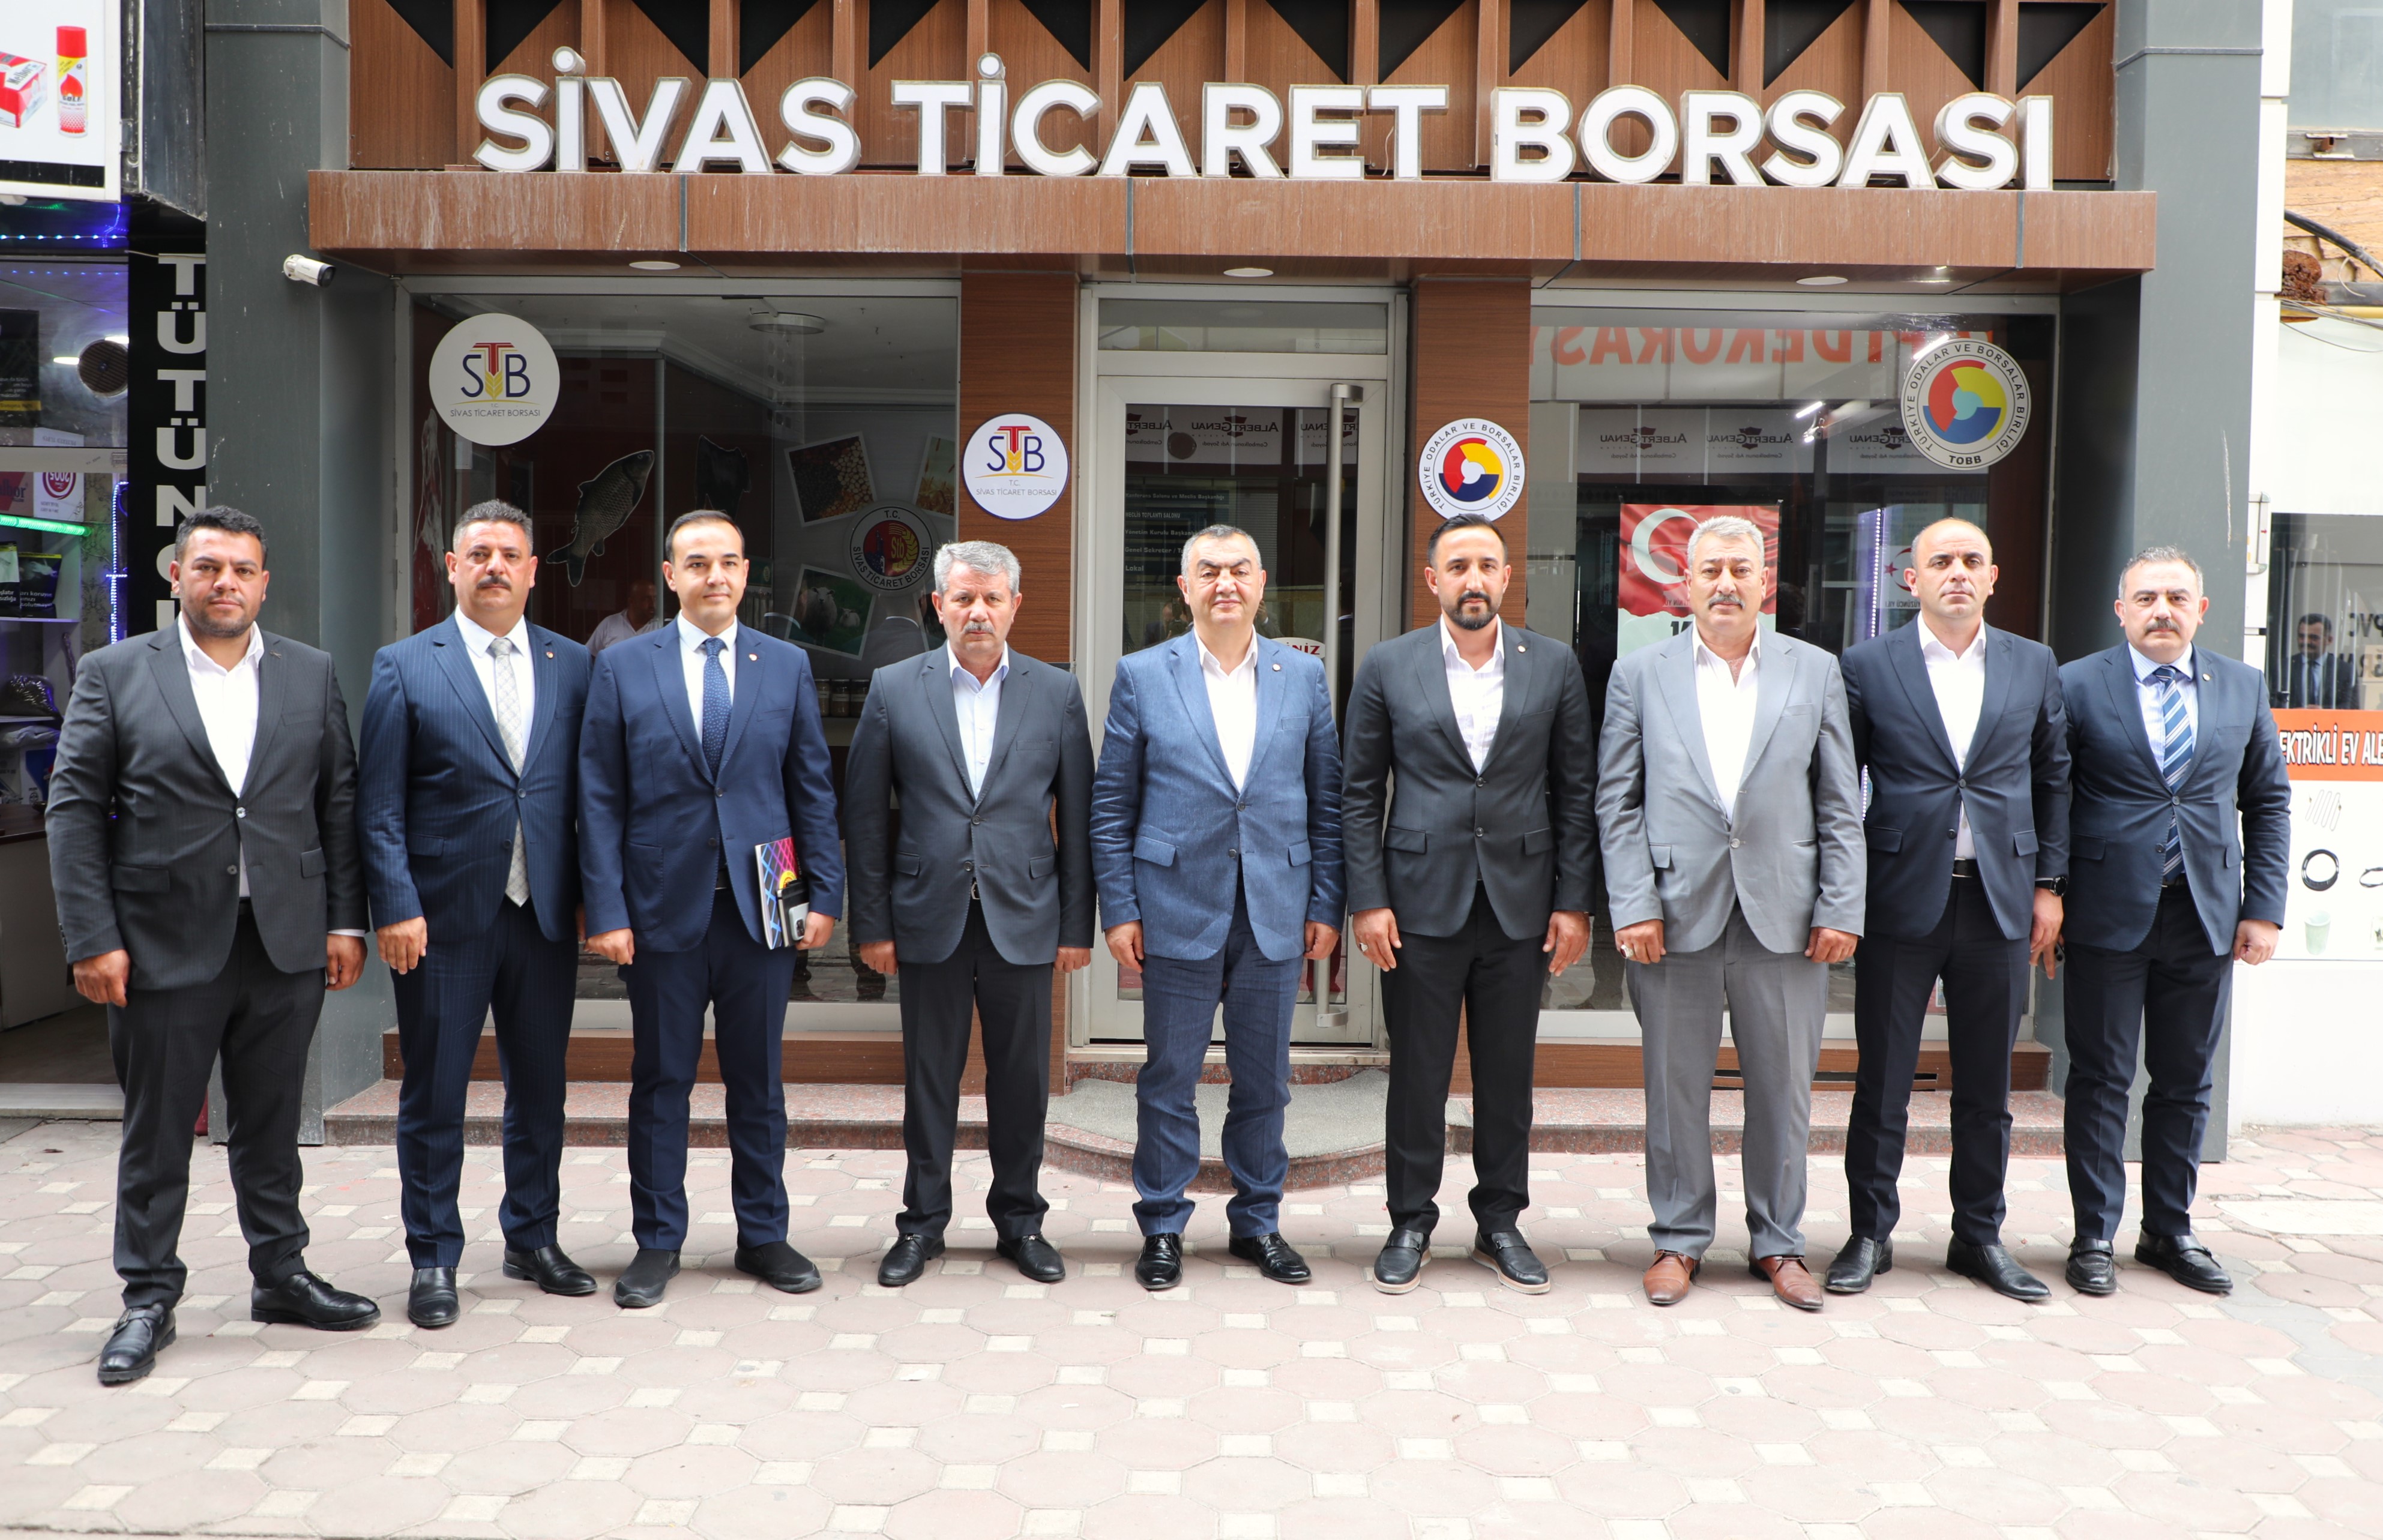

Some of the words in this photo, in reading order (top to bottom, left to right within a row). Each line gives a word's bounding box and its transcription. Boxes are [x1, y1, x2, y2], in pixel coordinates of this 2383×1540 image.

[472, 46, 861, 175] SİVAS
[891, 52, 1449, 179] TİCARET
[1490, 84, 2053, 190] BORSASI
[461, 342, 531, 397] STB
[1910, 347, 1950, 390] ODALAR
[1954, 344, 1971, 352] VE
[1977, 346, 2025, 400] BORSALAR
[156, 253, 206, 632] TÜTÜN
[1426, 426, 1458, 460] ODALAR
[1906, 396, 1932, 451] TÜRKİYE
[1996, 406, 2025, 453] BİRLİĞİ
[986, 426, 1045, 472] STB
[1481, 424, 1520, 469] BORSALAR
[1949, 454, 1982, 465] TOBB
[1424, 466, 1445, 510] TÜRKİYE
[1497, 475, 1520, 512] BİRLİĞİ
[884, 510, 900, 519] T.C.
[853, 547, 867, 573] SİVAS
[866, 571, 903, 588] TİCARET
[905, 547, 930, 583] BORSASI
[2341, 730, 2360, 765] EV
